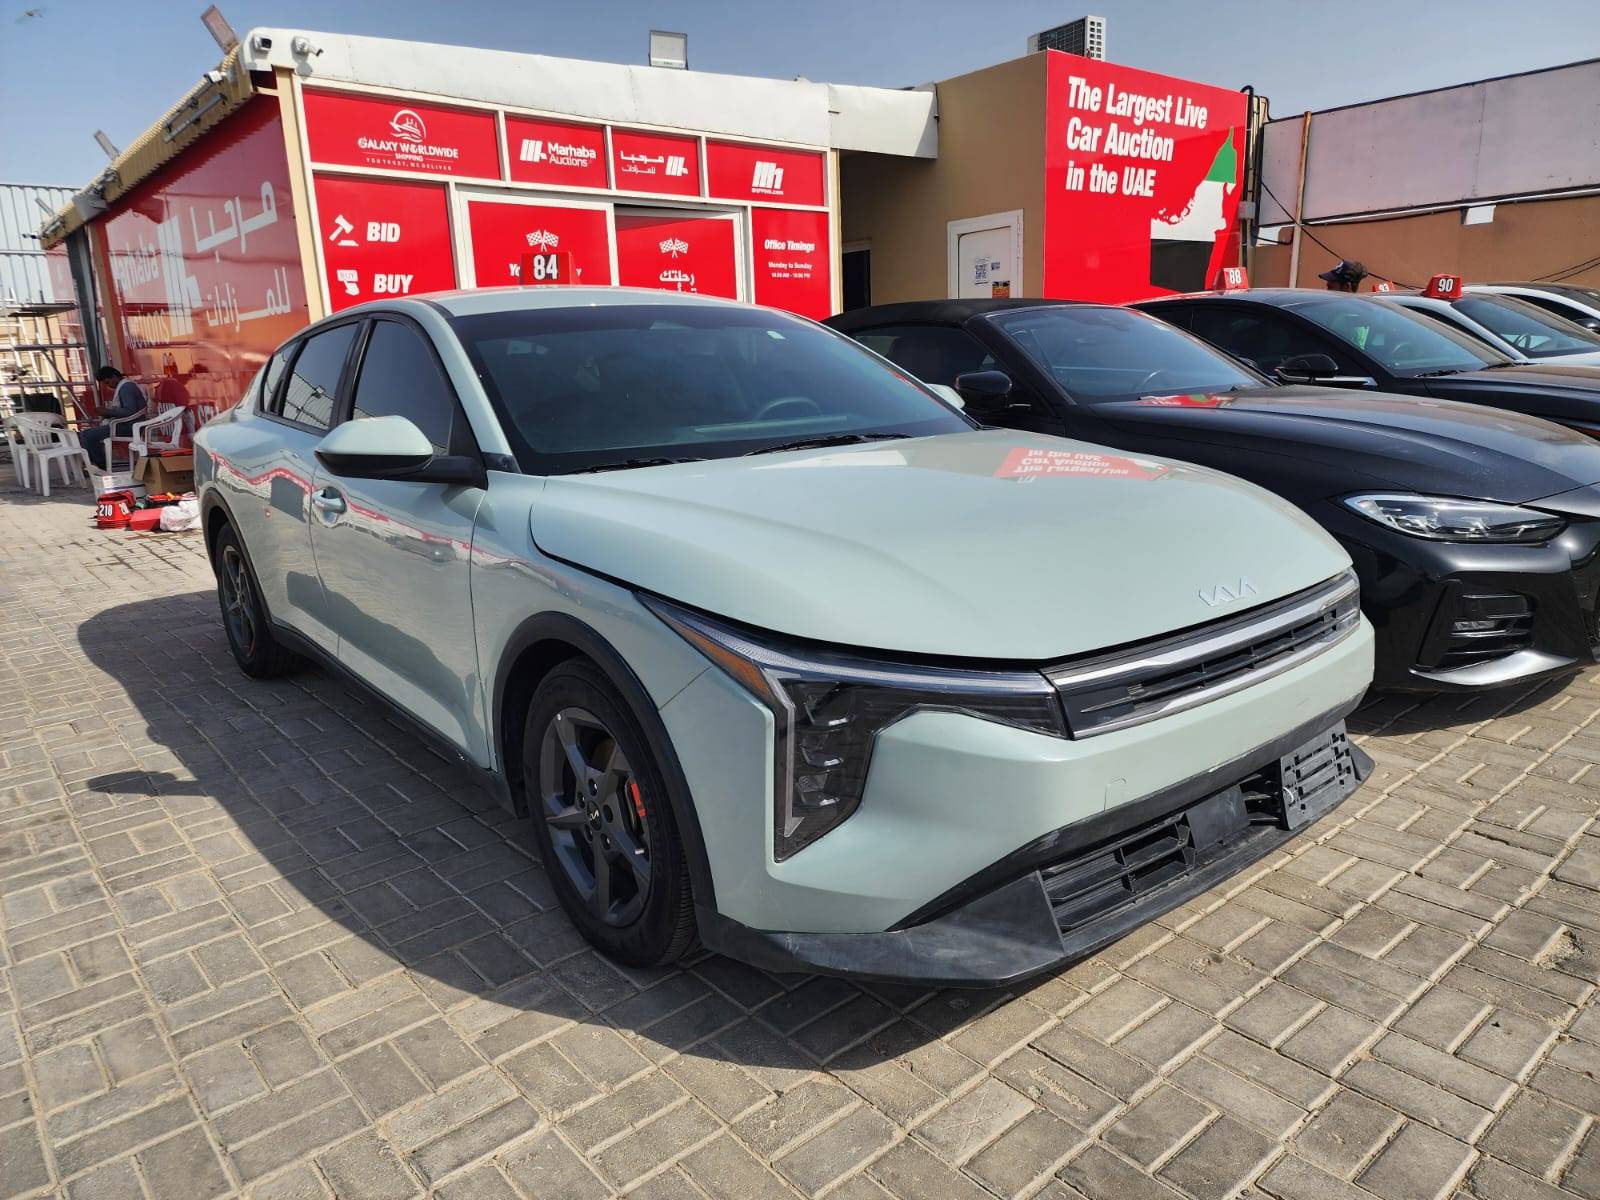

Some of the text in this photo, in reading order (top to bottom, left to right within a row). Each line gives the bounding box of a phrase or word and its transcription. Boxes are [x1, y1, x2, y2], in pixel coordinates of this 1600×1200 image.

[1068, 76, 1208, 129] The Largest Live
[358, 137, 459, 158] GALAXY WORLDWIDE
[1066, 117, 1174, 161] Car Auction
[547, 142, 596, 159] Marhaba
[620, 150, 664, 164] مرحبا
[549, 155, 588, 167] Auctions
[1065, 161, 1156, 197] in the UAE
[366, 222, 400, 242] BID
[764, 239, 815, 253] Office Timings
[533, 254, 558, 280] 84
[1229, 268, 1242, 284] 88
[373, 273, 414, 293] BUY
[1438, 279, 1453, 292] 90
[100, 504, 113, 517] 210
